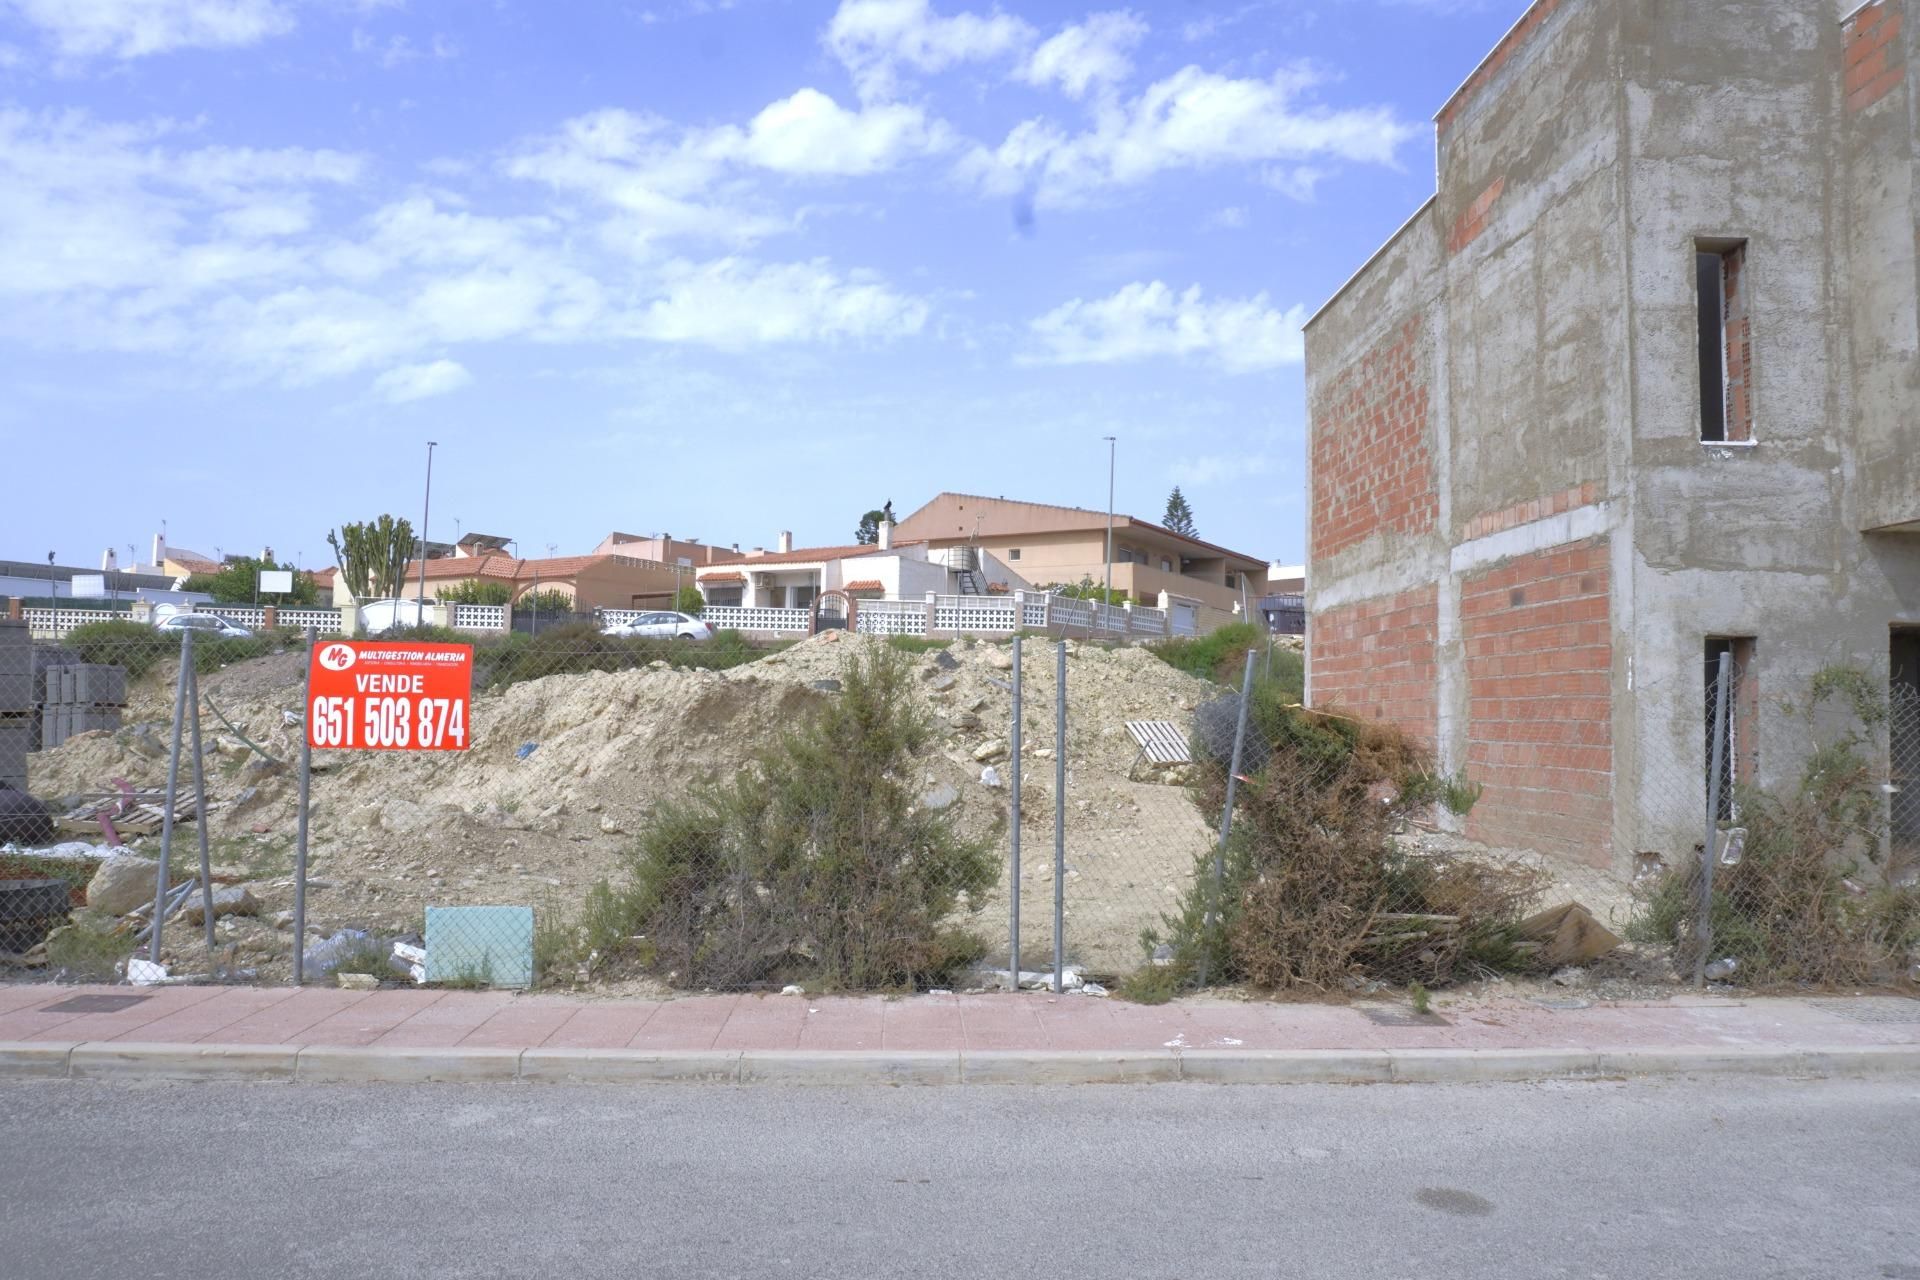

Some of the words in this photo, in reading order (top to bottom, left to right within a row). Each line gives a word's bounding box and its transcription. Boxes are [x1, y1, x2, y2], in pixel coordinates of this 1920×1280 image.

[328, 647, 349, 668] MG
[358, 650, 423, 661] MULTIGESTION
[425, 651, 465, 662] ALMERIA
[355, 674, 424, 694] VENDE
[312, 695, 354, 746] 651
[364, 696, 411, 747] 503
[418, 697, 465, 748] 874
